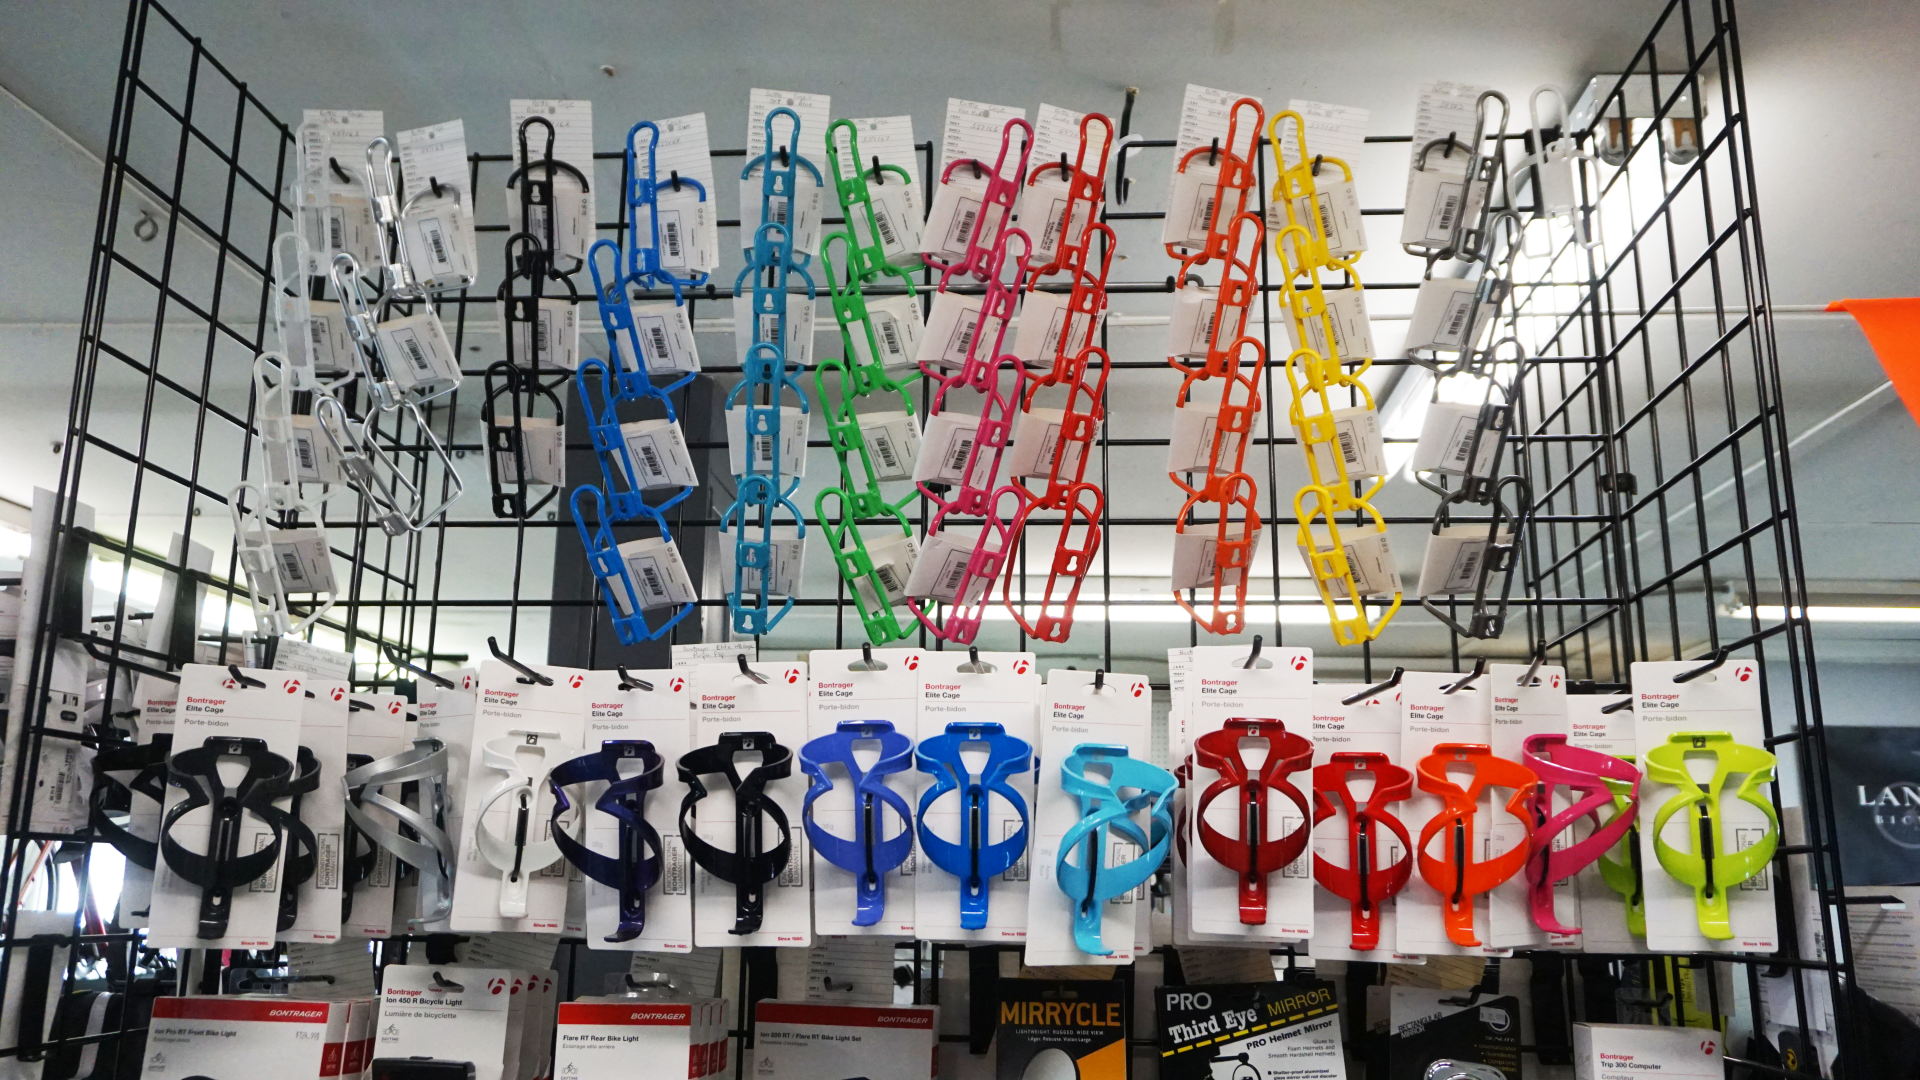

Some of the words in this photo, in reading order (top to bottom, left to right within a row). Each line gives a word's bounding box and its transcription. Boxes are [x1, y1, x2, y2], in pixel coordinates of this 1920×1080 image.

[818, 682, 854, 691] Bontrager
[925, 683, 962, 692] Bontrager
[1201, 679, 1238, 688] Bontrager
[485, 688, 519, 698] Bontrager
[835, 690, 853, 698] Cage
[942, 692, 961, 700] Cage
[1218, 688, 1238, 696] Cage
[187, 696, 227, 706] Bontrager
[484, 696, 499, 705] Elite
[500, 698, 518, 706] Cage
[702, 694, 736, 703] Bontrager
[1495, 697, 1519, 705] Bontrager
[1641, 692, 1680, 702] Bontrager
[186, 705, 203, 713] Elite
[204, 706, 225, 714] Cage
[592, 702, 624, 711] Bontrager
[718, 703, 736, 711] Cage
[818, 703, 860, 711] Porte-bidon
[1053, 702, 1086, 711] Bontrager
[1201, 701, 1244, 709] Porte-bidon
[1410, 704, 1445, 713] Bontrager
[1506, 705, 1519, 713] Cage
[1641, 701, 1658, 709] Elite
[1659, 701, 1680, 710] Cage
[482, 710, 522, 719] Porte-bidon
[591, 710, 607, 718] Elite
[1053, 711, 1067, 719] Elite
[1068, 712, 1085, 720] Cage
[1410, 712, 1425, 720] Elite
[1426, 713, 1444, 721] Cage
[184, 718, 230, 728] Porte-bidon
[1642, 715, 1688, 723] Porte-bidon
[592, 723, 629, 731] Porte-bidon
[1052, 725, 1089, 734] Porte-bidon
[1327, 723, 1345, 731] Cage
[1410, 725, 1450, 734] Porte-bidon
[1573, 723, 1607, 732] Bontrager
[1588, 731, 1607, 739] Cage
[387, 988, 422, 997] Bontrager
[419, 998, 444, 1006] Bicycle
[445, 999, 462, 1007] Light
[1166, 991, 1212, 1011] PRO
[1266, 988, 1331, 1017] MIRROR
[269, 1009, 323, 1018] BONTRAGER
[384, 1010, 410, 1018] Lumière
[424, 1012, 457, 1020] bicyclette
[1001, 1001, 1121, 1027] MIRRYCLE
[877, 1015, 928, 1024] BONTRAGER
[1398, 1012, 1443, 1032] RECTANGULAR
[188, 1029, 204, 1037] Front
[1168, 1015, 1220, 1044] Third
[1400, 1025, 1426, 1039] MIRROR
[622, 1035, 639, 1043] Light
[835, 1035, 850, 1043] Light
[1246, 1038, 1267, 1050] PRO
[1269, 1028, 1302, 1044] Helmet
[1303, 1019, 1333, 1034] Mirror
[1600, 1053, 1634, 1061] Bontrager
[1601, 1061, 1614, 1069] Trip
[1628, 1062, 1661, 1070] Computer
